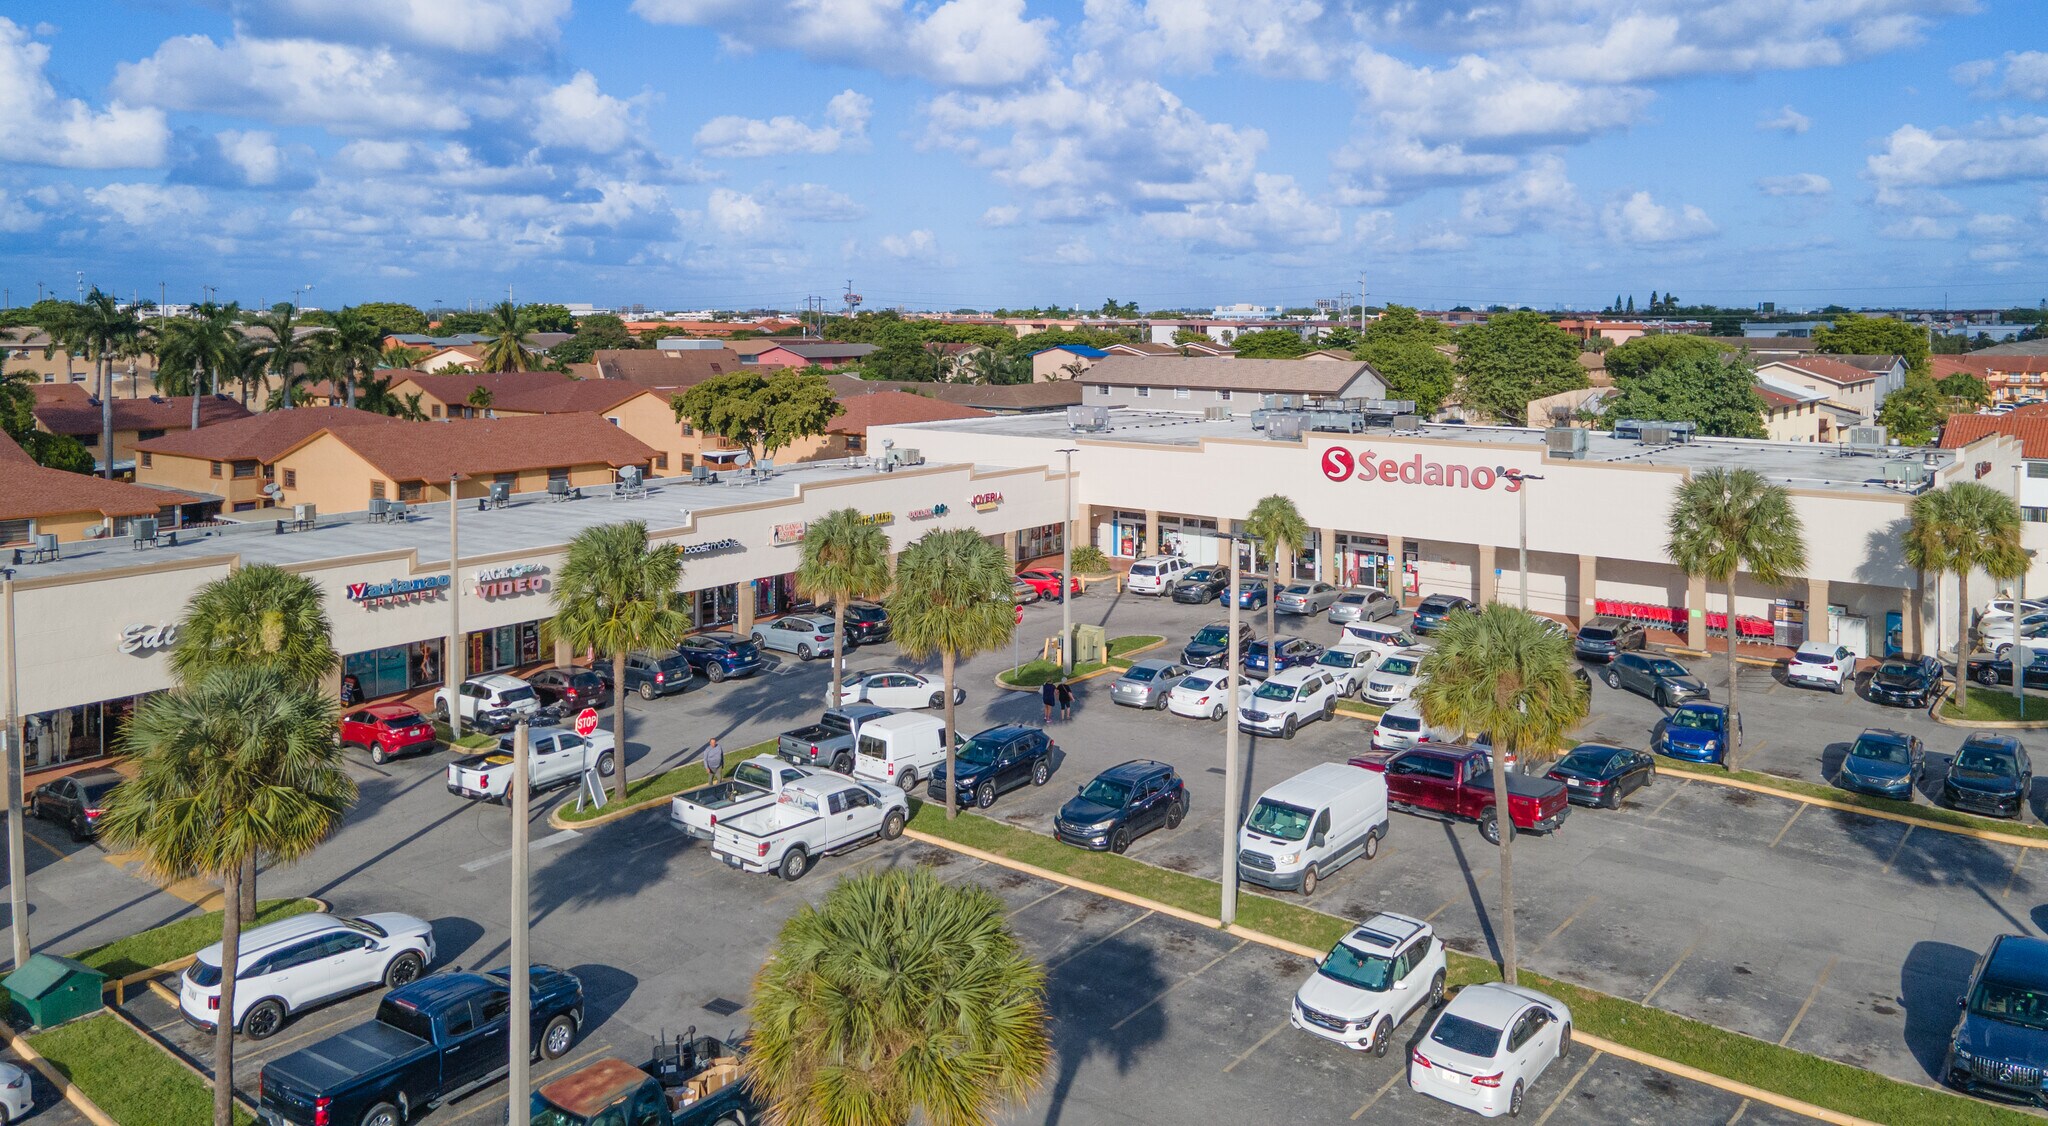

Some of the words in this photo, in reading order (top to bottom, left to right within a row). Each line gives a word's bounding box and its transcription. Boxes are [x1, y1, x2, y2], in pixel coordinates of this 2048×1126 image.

[1358, 450, 1522, 493] Sedano's
[971, 492, 1003, 505] JOYERIA
[476, 575, 543, 600] VIDEO
[361, 589, 440, 611] TRAVEL
[577, 715, 597, 729] STOP
